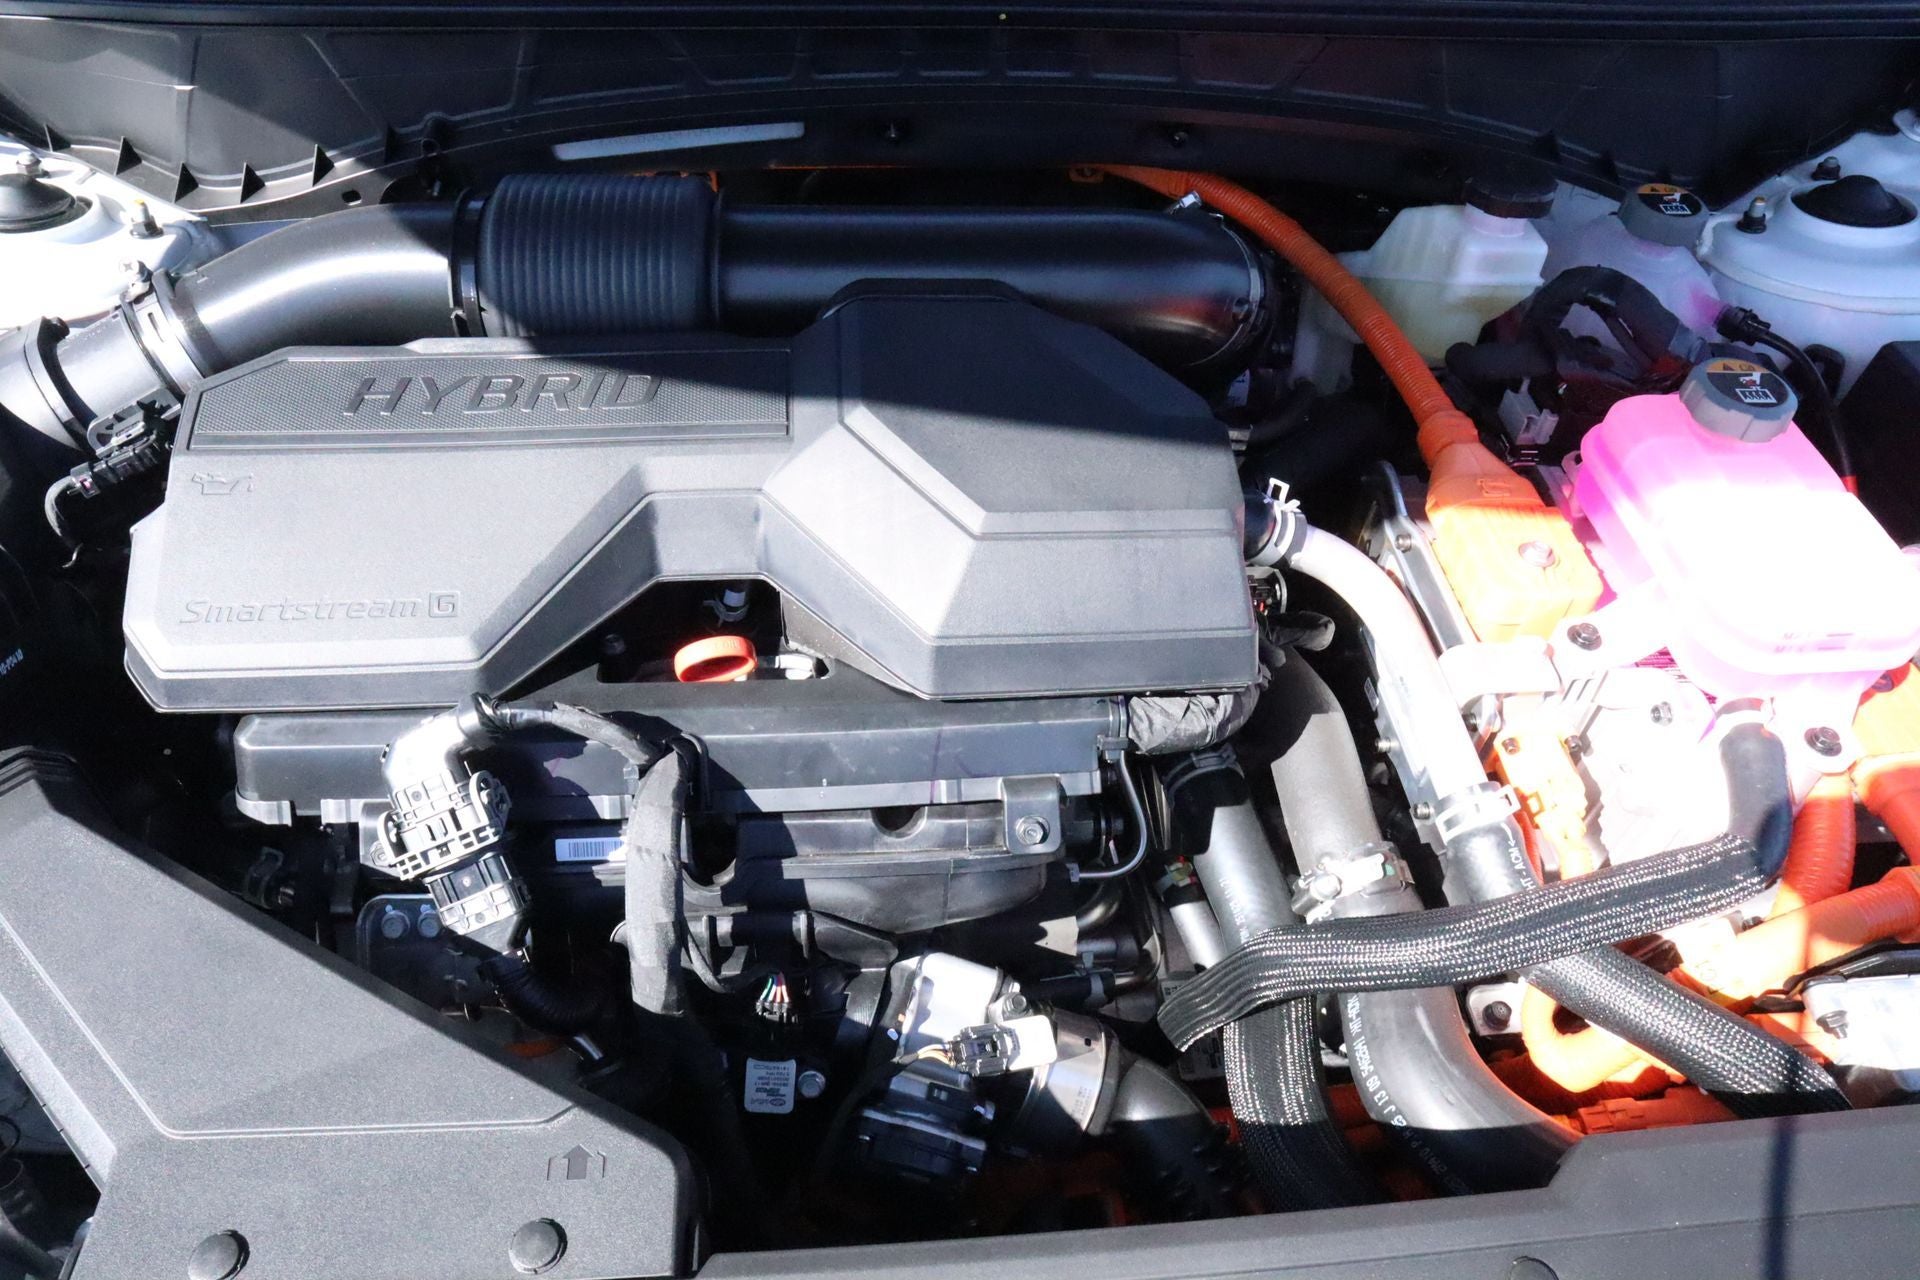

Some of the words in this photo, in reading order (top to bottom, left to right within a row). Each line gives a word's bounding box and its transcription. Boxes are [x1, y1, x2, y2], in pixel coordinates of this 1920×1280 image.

[343, 371, 662, 416] HYBRID
[179, 597, 422, 624] Smartstream
[433, 592, 458, 617] G
[1373, 1090, 1389, 1106] 13
